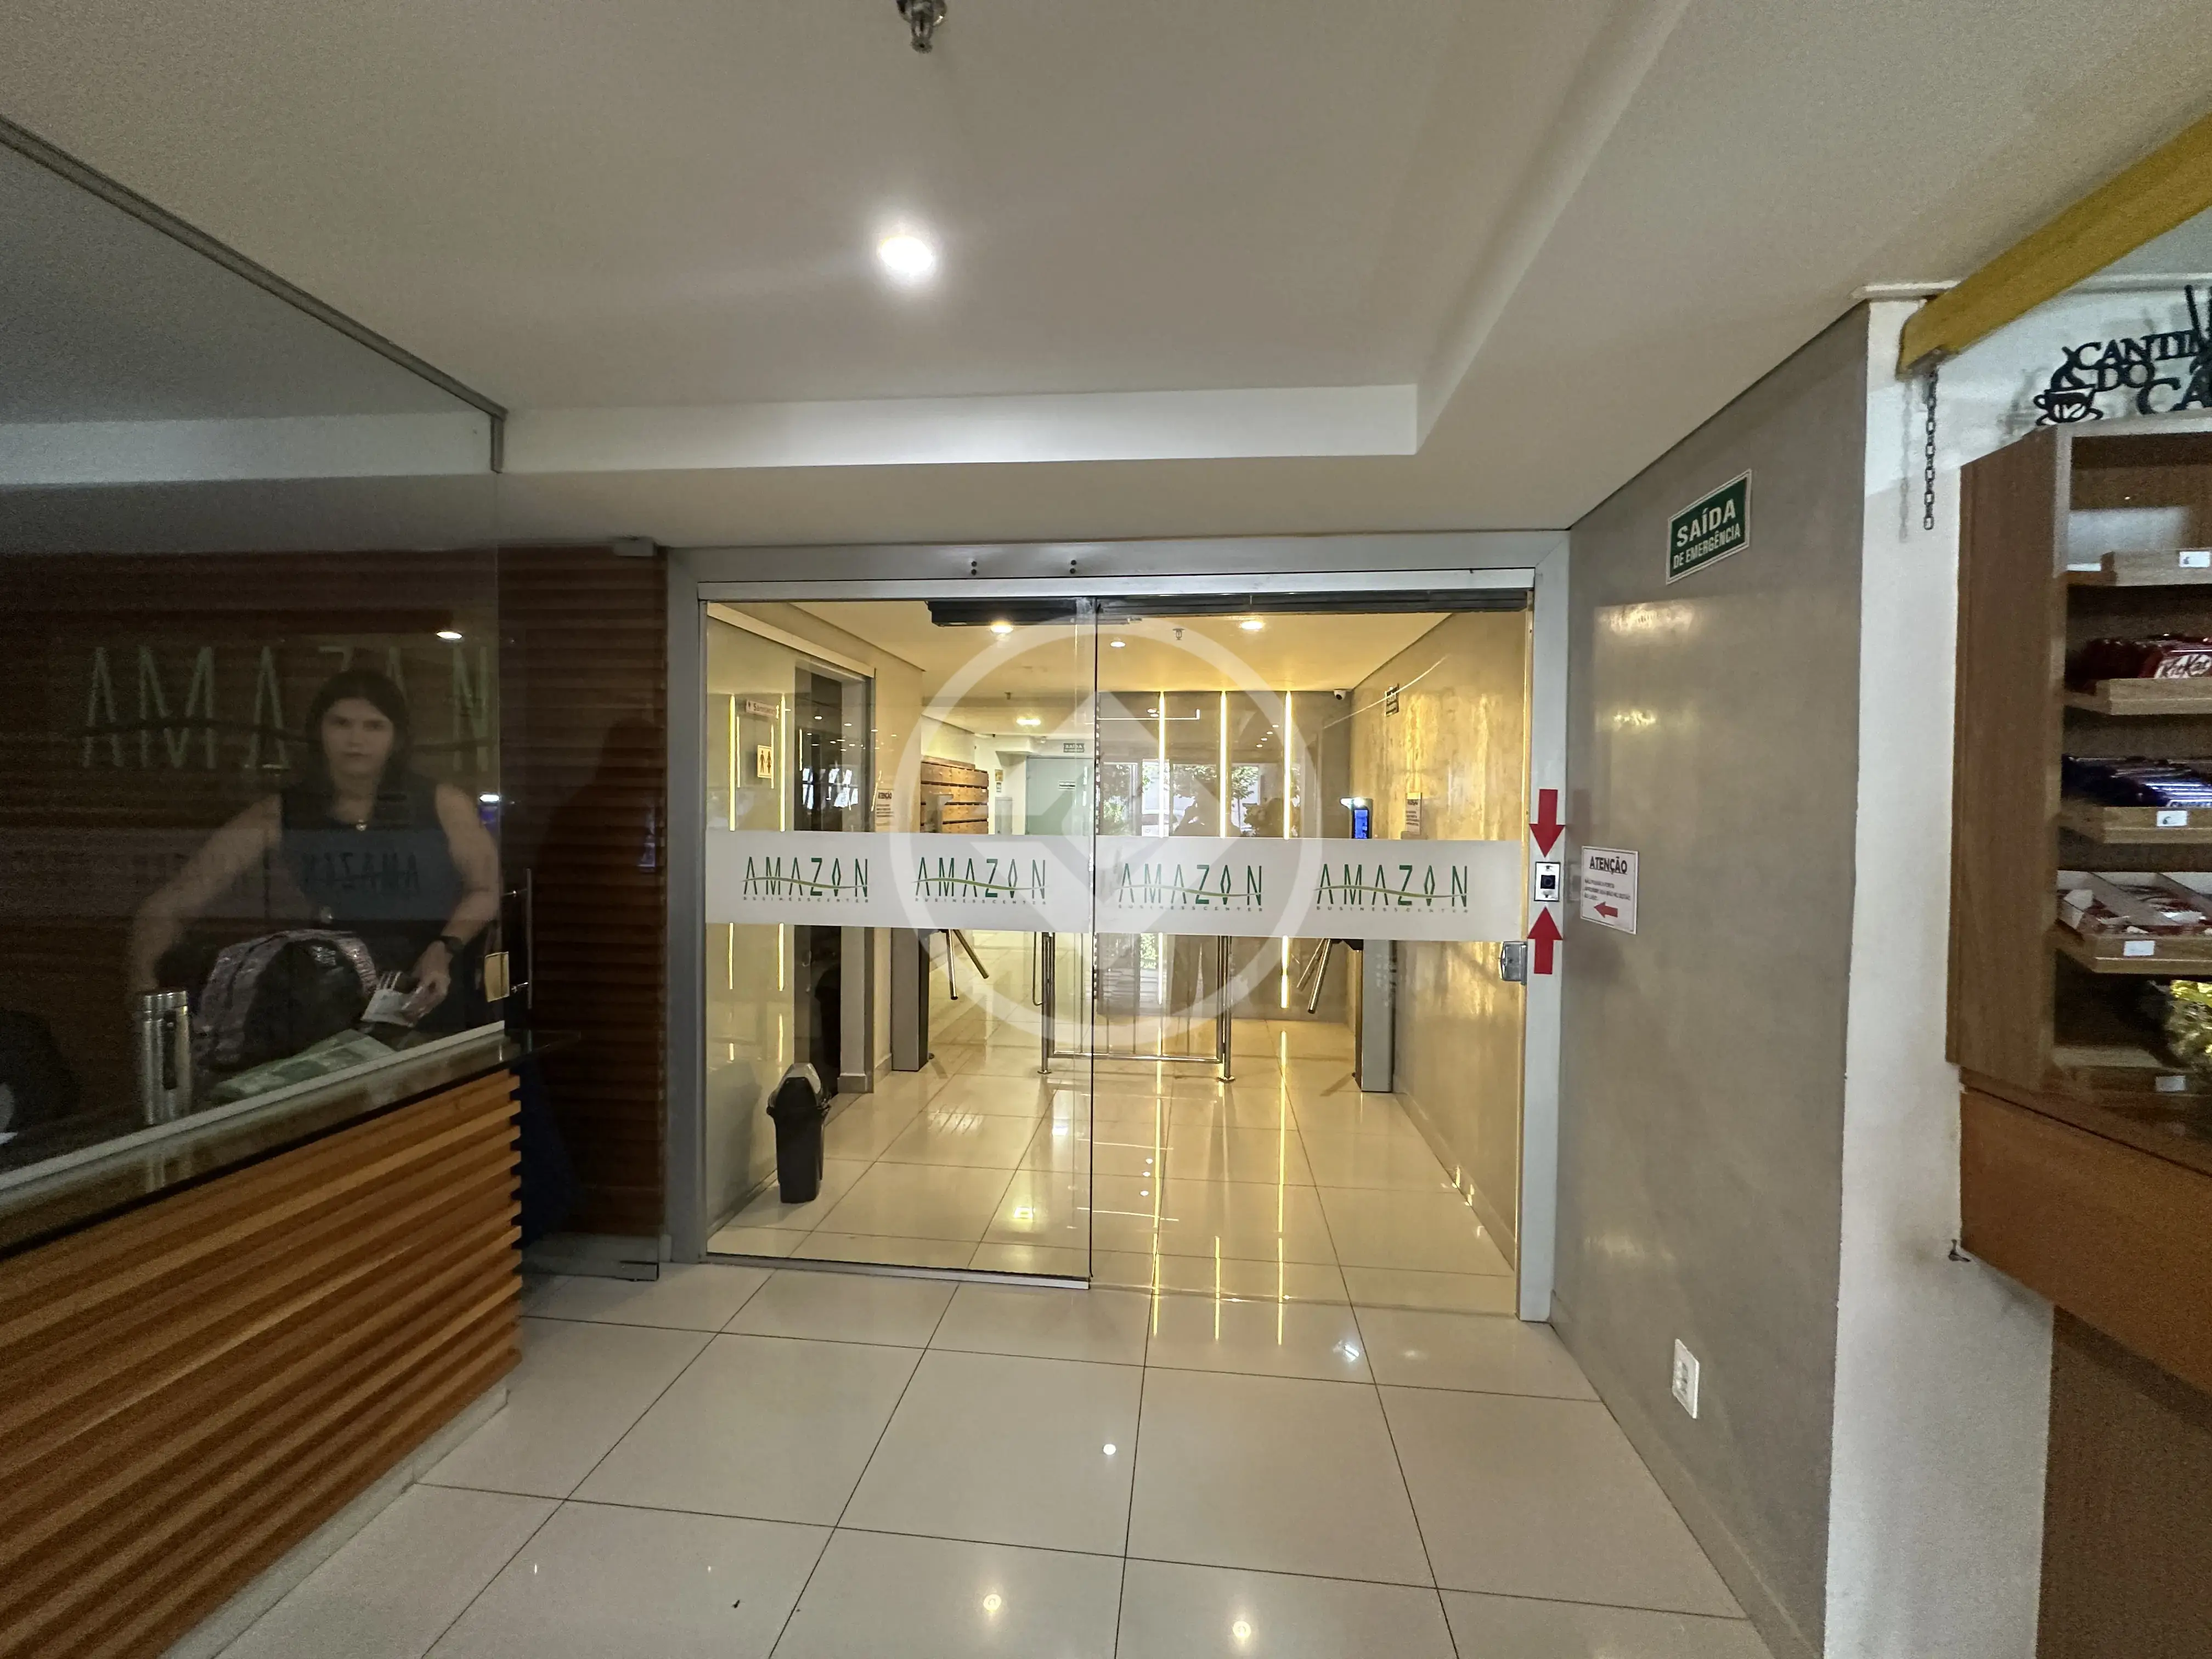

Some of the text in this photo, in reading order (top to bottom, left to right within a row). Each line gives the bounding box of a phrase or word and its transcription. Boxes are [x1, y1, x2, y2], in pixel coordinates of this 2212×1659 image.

[2097, 362, 2155, 392] DO
[1677, 498, 1736, 547] SAÍDA
[1673, 522, 1741, 569] DE EMERGÊNCIA
[743, 856, 868, 898] AMAZON
[915, 857, 1046, 899] AMAZON
[1118, 863, 1262, 906] AMAZON
[1317, 864, 1468, 907] AMAZON
[1589, 856, 1628, 875] ATENÇÃO
